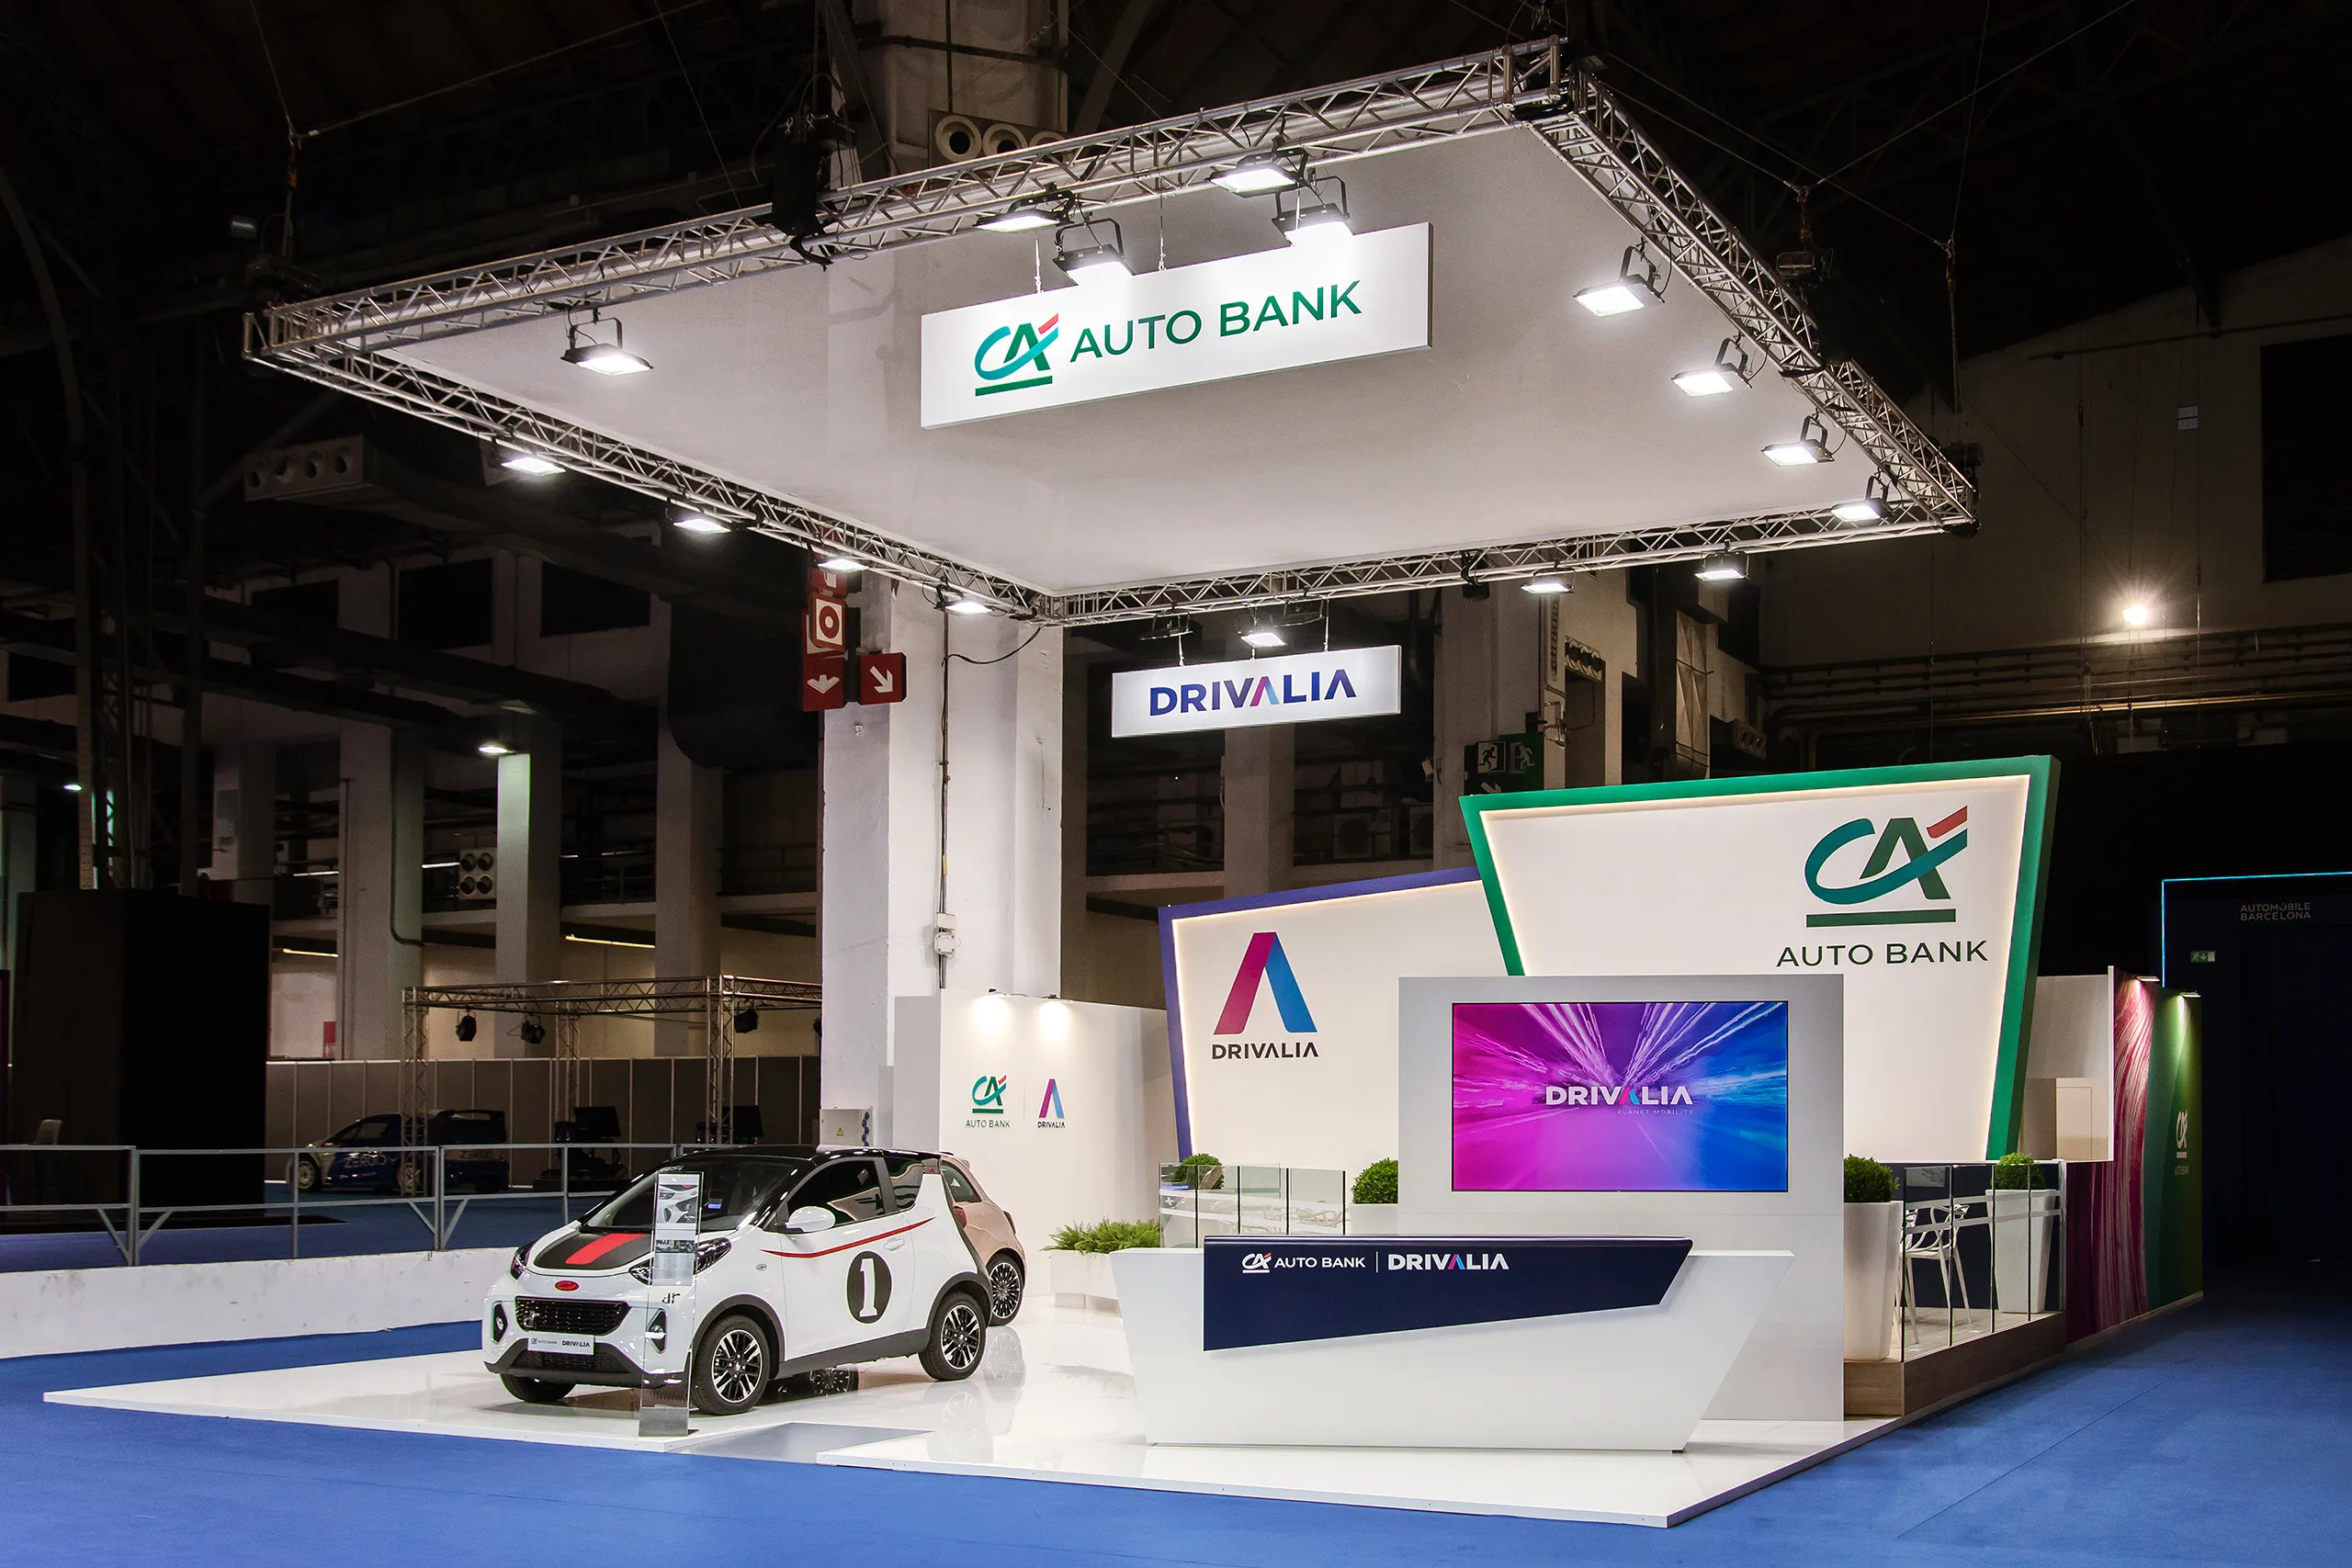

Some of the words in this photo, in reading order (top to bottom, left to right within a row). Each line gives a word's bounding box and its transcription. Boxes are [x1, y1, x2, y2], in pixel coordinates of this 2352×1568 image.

[1069, 310, 1203, 363] AUTO
[1220, 279, 1363, 337] BANK
[1149, 669, 1357, 716] DRIVALIA
[2240, 902, 2312, 912] AUTOMOBILE
[2240, 911, 2312, 921] BARCELONA
[1776, 944, 1873, 967] AUTO
[1886, 941, 1988, 964] BANK
[1212, 1042, 1319, 1060] DRIVALIA
[1544, 1085, 1694, 1106] DRIVALIA
[965, 1119, 988, 1128] AUTO
[989, 1119, 1011, 1128] BANK
[1273, 1257, 1317, 1269] AUTO
[1321, 1257, 1366, 1269] BANK
[1387, 1253, 1510, 1270] DRIVALIA
[859, 1258, 878, 1318] 1
